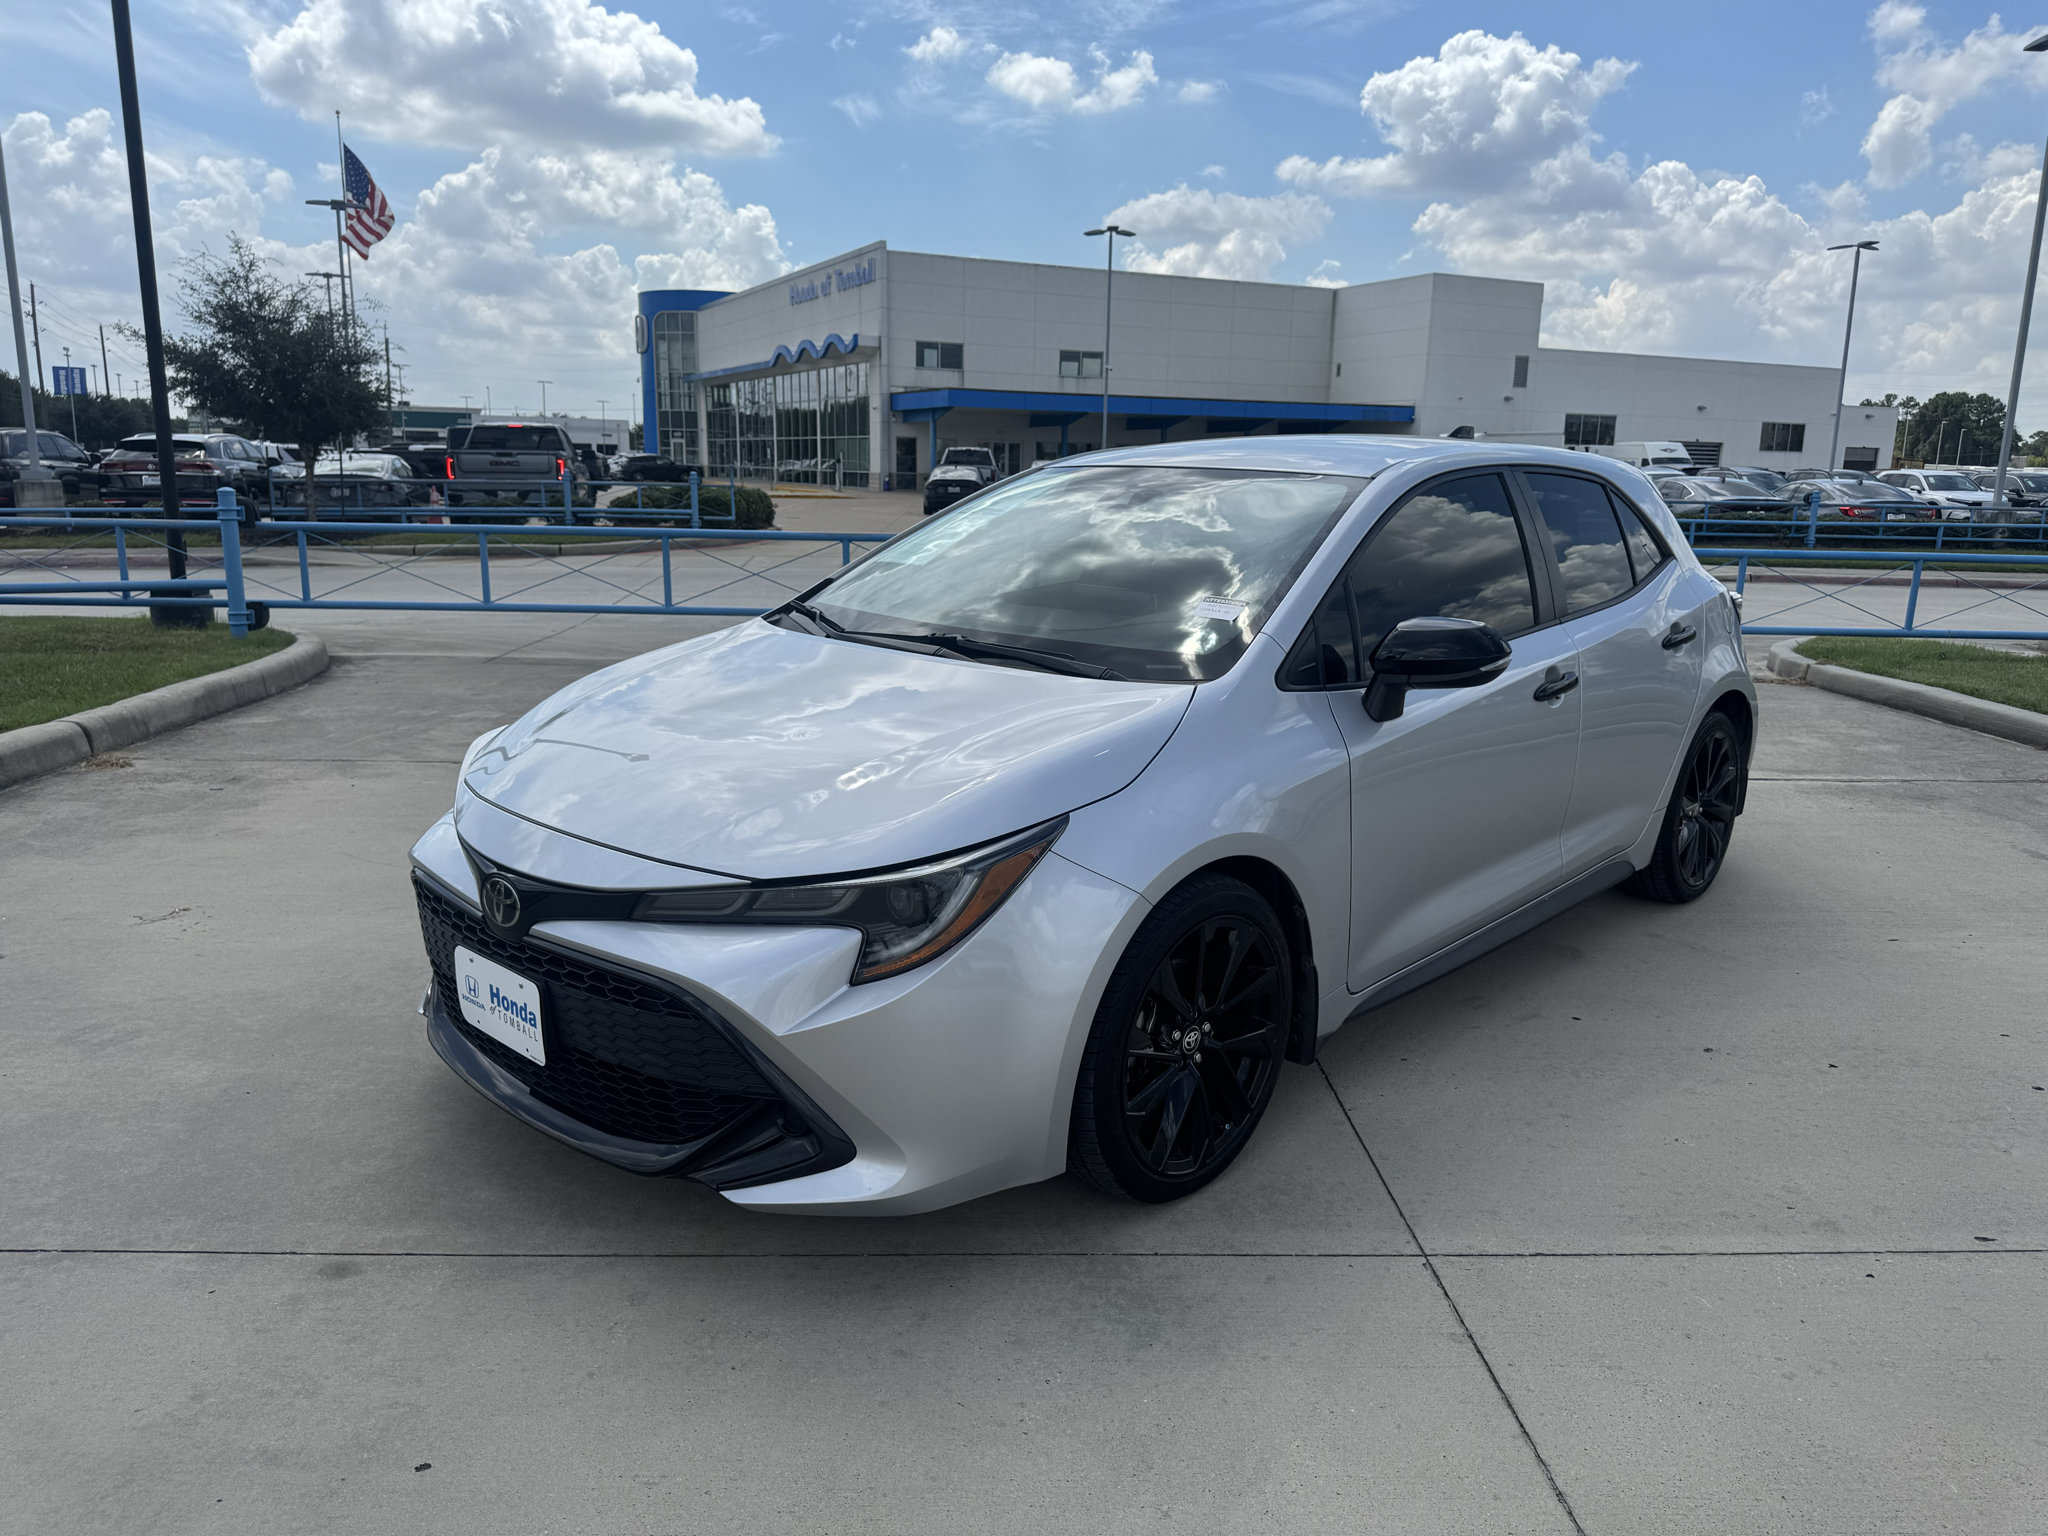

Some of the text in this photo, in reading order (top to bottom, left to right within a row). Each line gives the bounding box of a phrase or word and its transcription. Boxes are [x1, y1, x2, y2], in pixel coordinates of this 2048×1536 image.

[789, 257, 877, 305] Honda of Tomball
[462, 993, 486, 1011] HONDA
[489, 983, 537, 1029] Honda
[489, 1005, 538, 1042] of TOMBALL
